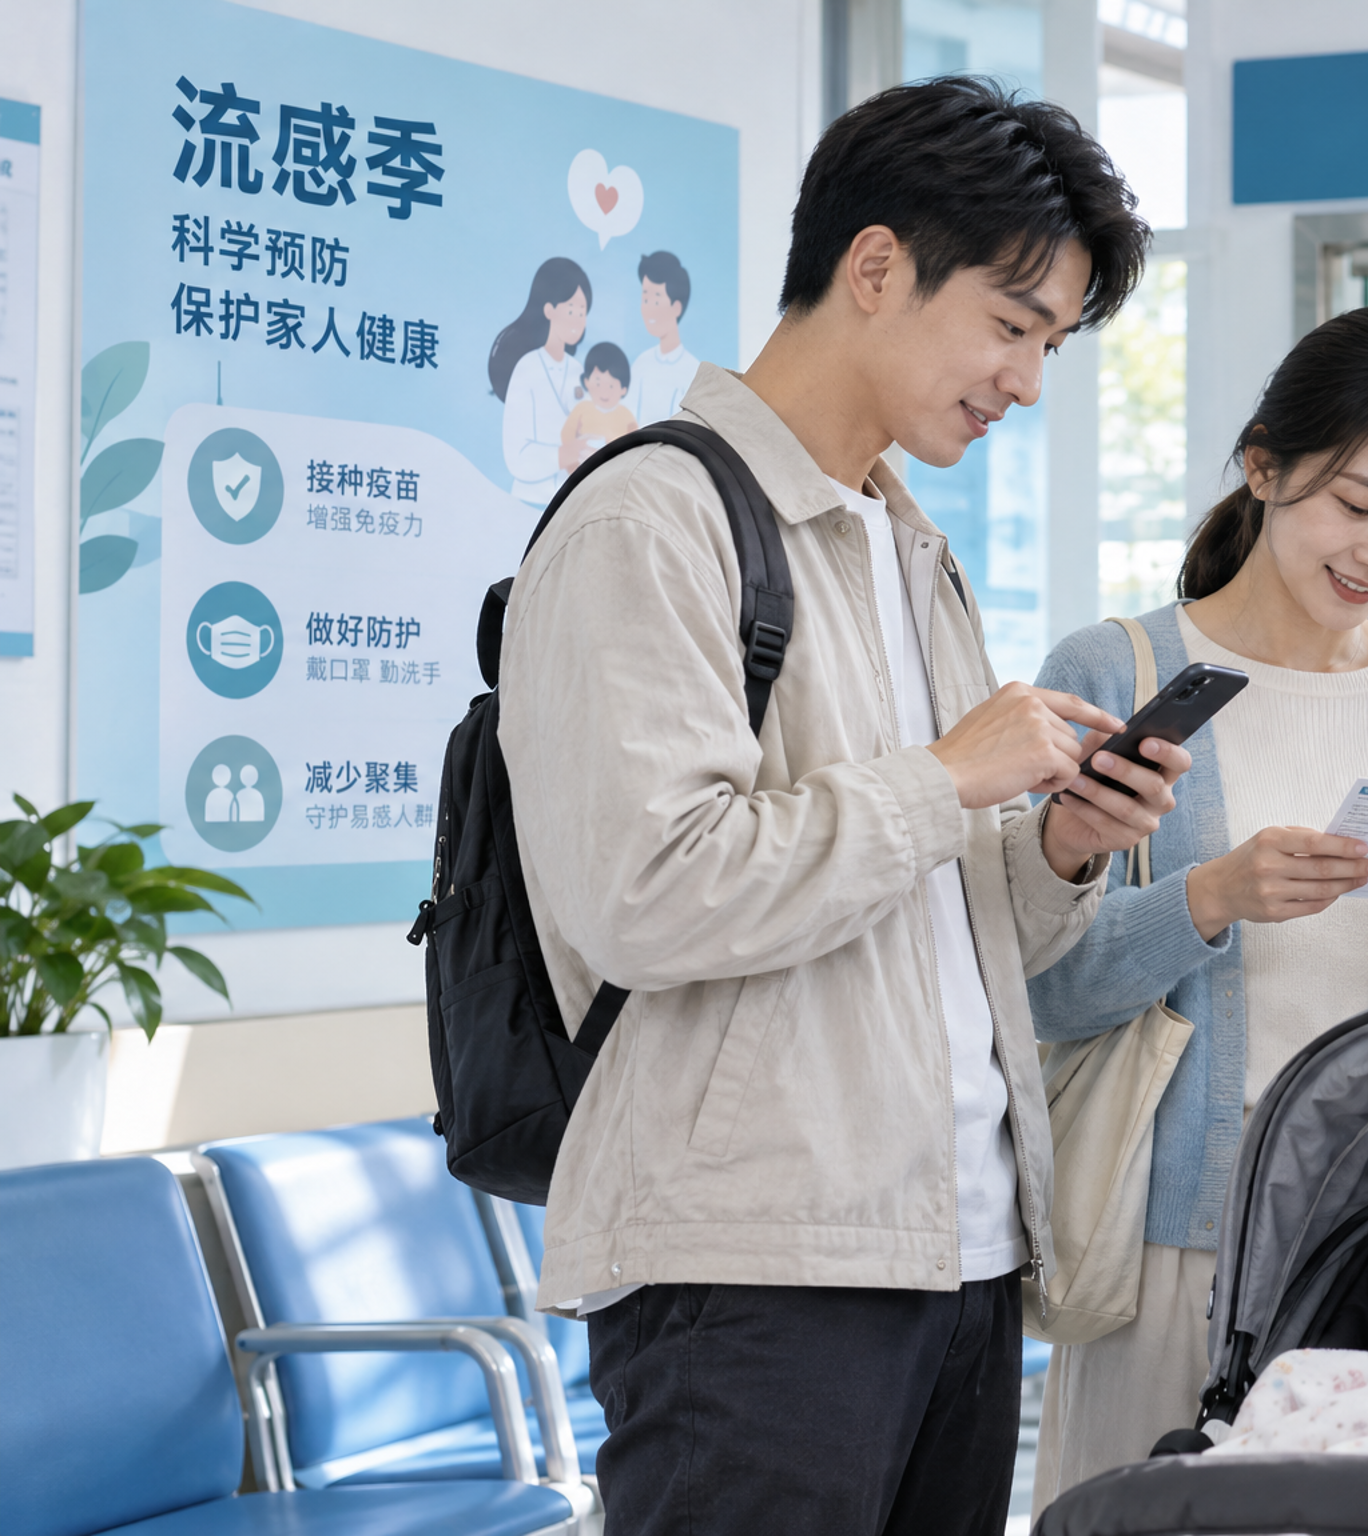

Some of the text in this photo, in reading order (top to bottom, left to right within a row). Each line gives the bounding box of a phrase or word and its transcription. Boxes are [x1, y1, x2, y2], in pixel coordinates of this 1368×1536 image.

[171, 75, 446, 221] 流感季
[171, 213, 350, 288] 科学预防
[170, 281, 440, 371] 保护家人健康
[306, 458, 421, 503] 接种疫苗
[306, 502, 423, 538] 增强免疫力
[305, 611, 421, 650] 做好防护
[306, 655, 371, 684] 戴口罩
[304, 760, 419, 794] 减少聚集
